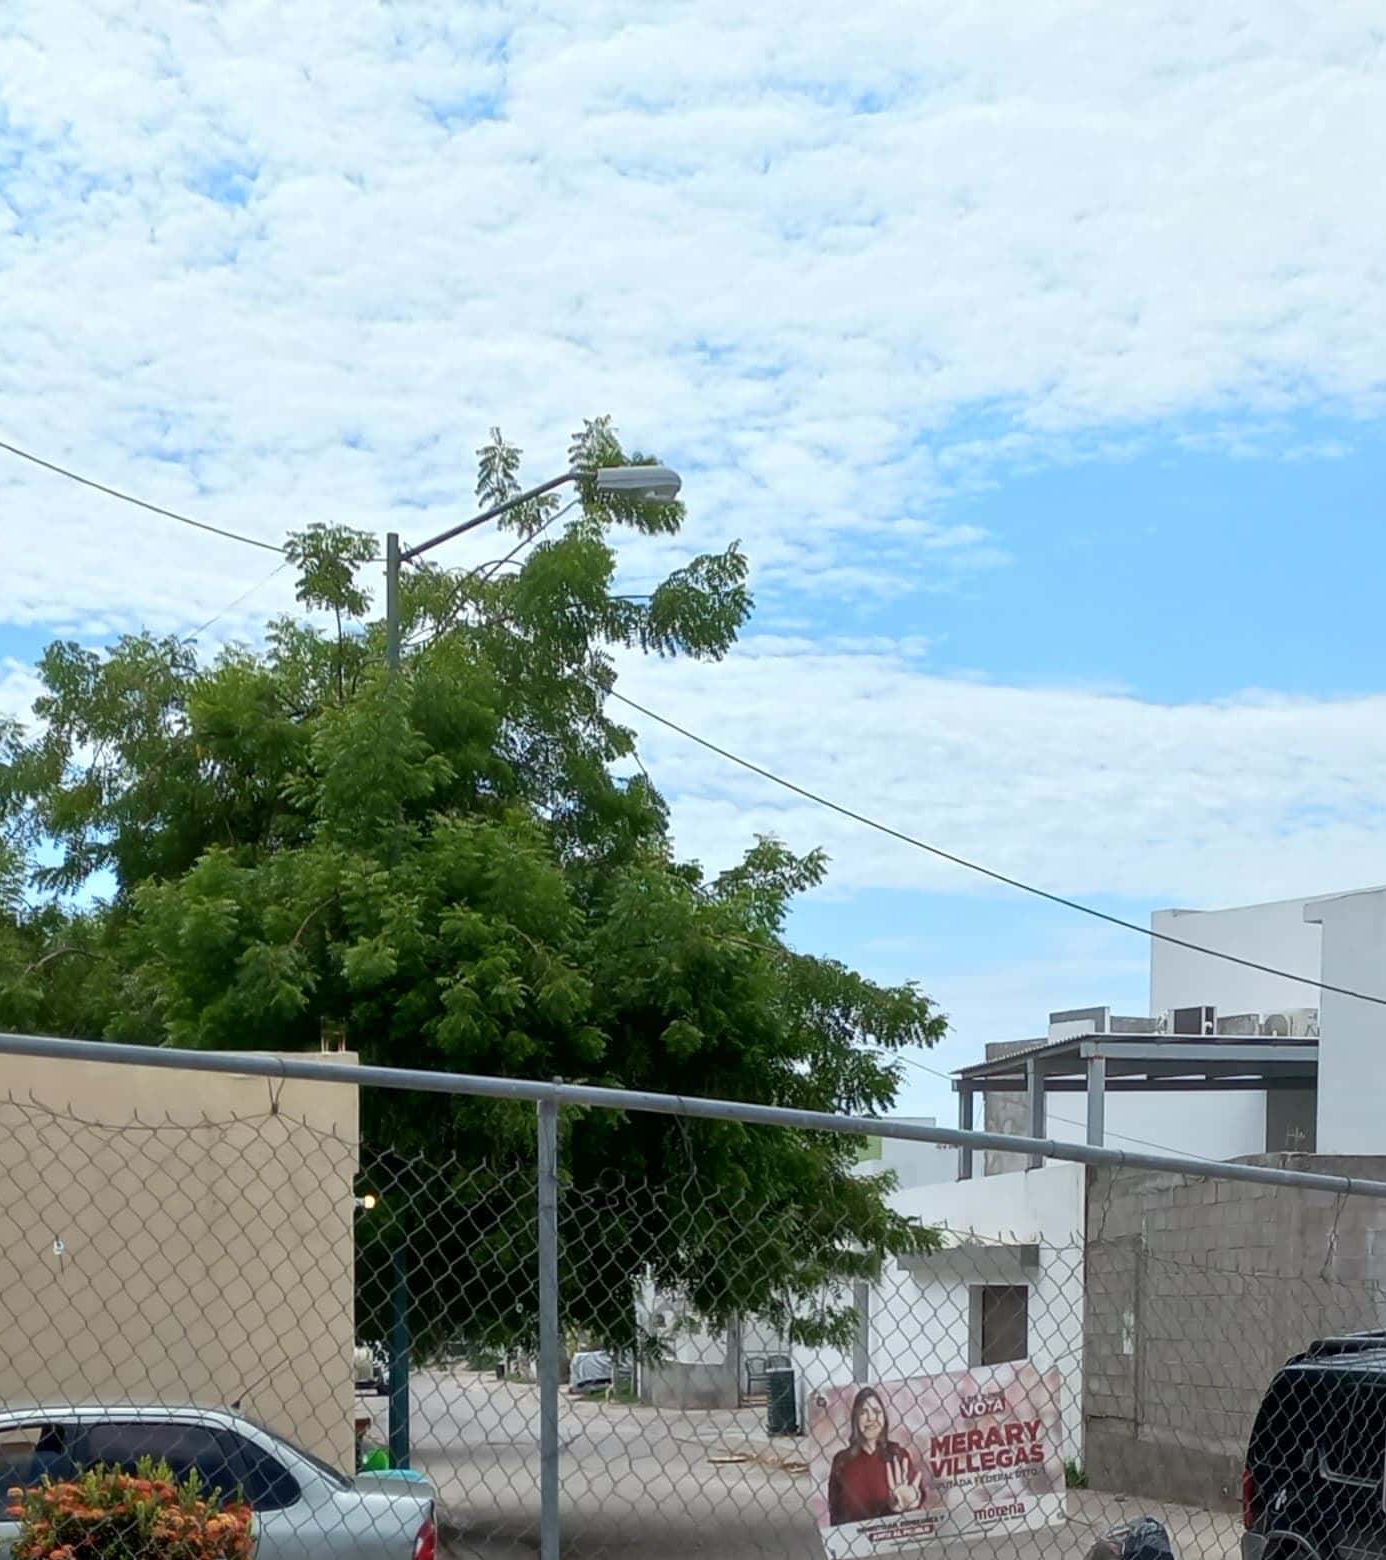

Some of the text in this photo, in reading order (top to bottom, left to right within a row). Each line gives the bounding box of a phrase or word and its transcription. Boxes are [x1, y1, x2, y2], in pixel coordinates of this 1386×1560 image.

[961, 1398, 1004, 1416] VOTA
[930, 1420, 1042, 1459] MERARY
[929, 1444, 1045, 1479] VILLEGAS
[973, 1503, 1025, 1520] morena
